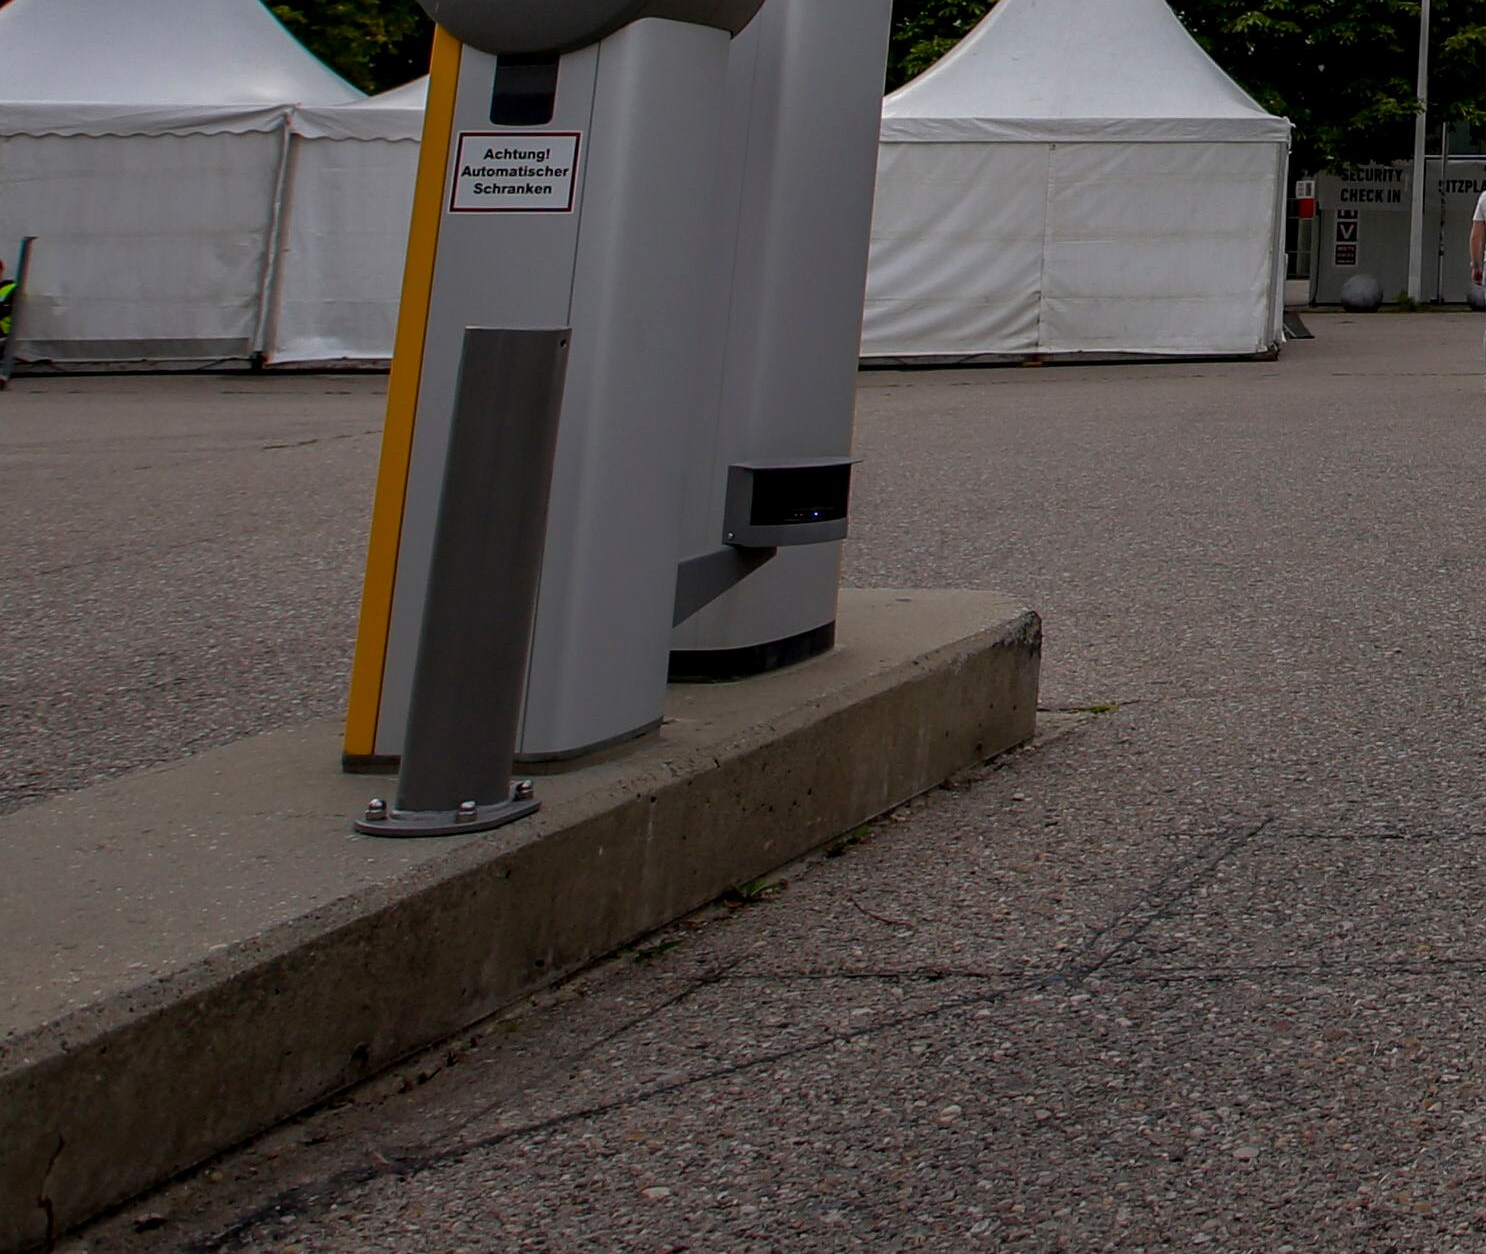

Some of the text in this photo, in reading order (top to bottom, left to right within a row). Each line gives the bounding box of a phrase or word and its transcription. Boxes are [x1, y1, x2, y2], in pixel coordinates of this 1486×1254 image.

[484, 148, 551, 162] Achtung!
[461, 166, 570, 177] Automatischer
[1341, 168, 1402, 182] SECURITY
[473, 183, 552, 194] Schranken
[1340, 188, 1401, 203] CHECK IN
